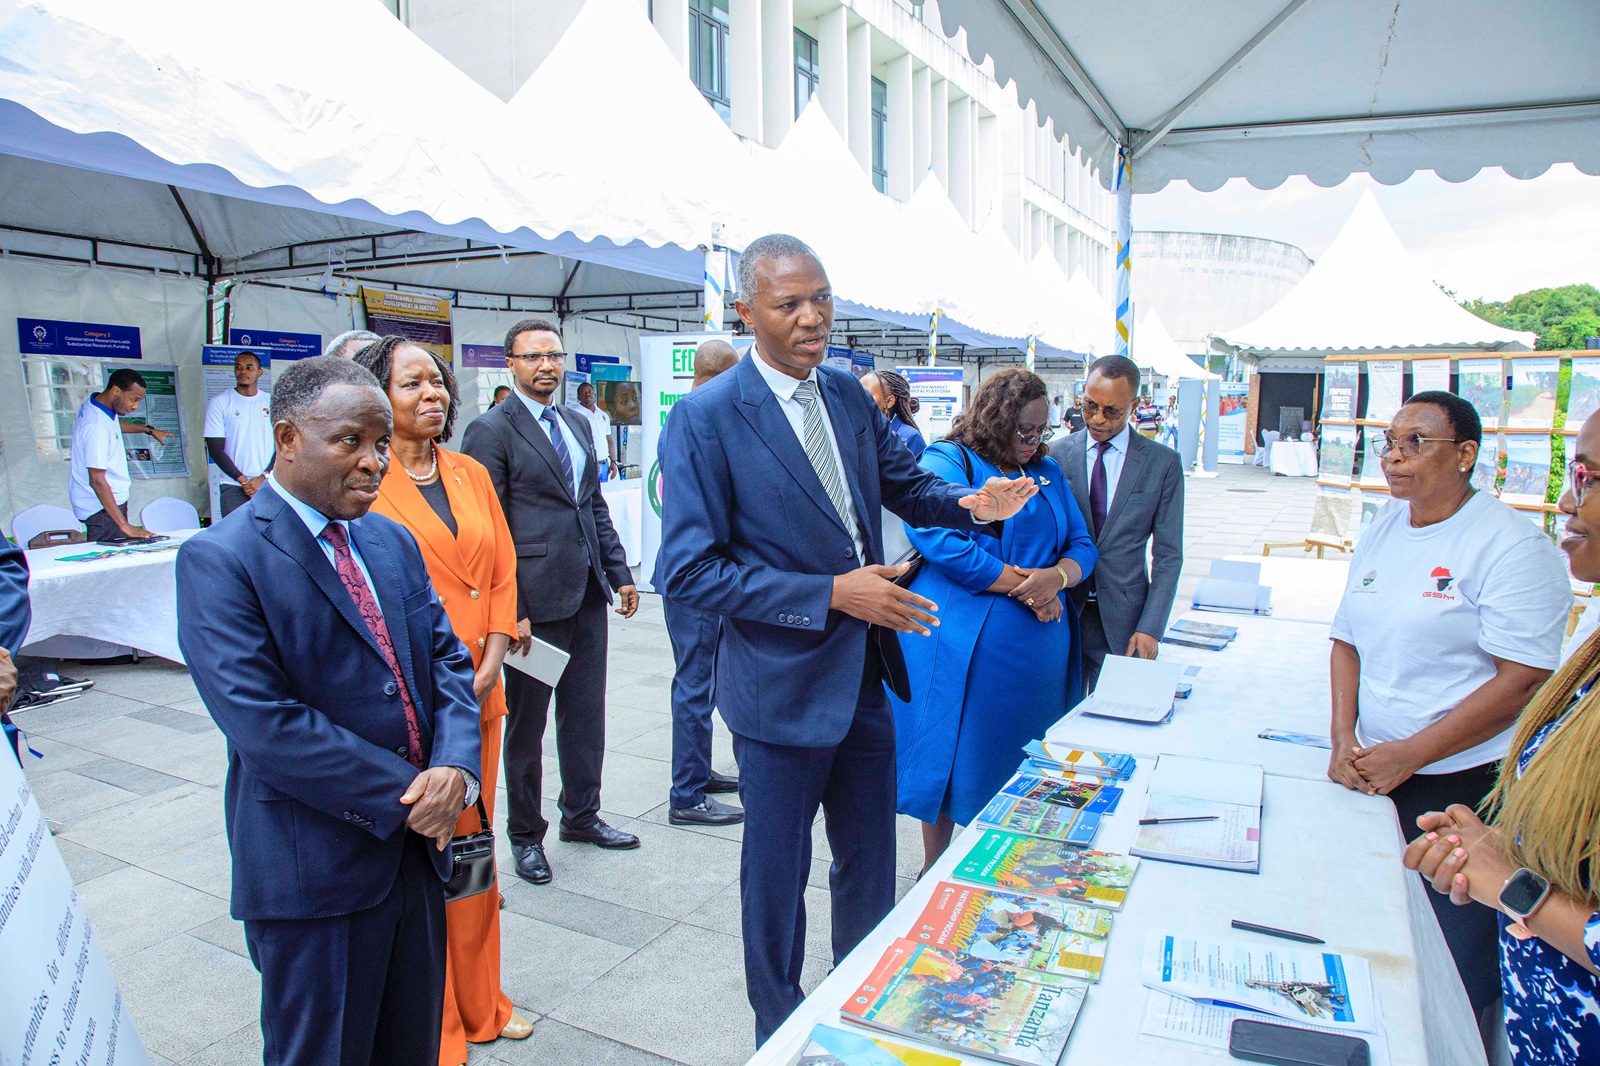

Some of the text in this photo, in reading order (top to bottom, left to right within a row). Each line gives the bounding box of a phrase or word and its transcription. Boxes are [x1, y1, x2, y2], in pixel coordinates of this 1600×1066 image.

[673, 349, 697, 372] EfD
[1422, 591, 1455, 600] GSM
[17, 854, 32, 885] with
[980, 859, 997, 877] PROGRAM
[991, 838, 1035, 880] Tanzania
[994, 836, 1014, 860] PARTNERSHIP
[937, 890, 969, 944] PARTNERSHIP PROGRAM
[950, 892, 994, 949] Tanzania
[47, 959, 60, 985] for
[56, 906, 73, 957] different
[56, 1030, 66, 1050] to
[63, 981, 80, 1031] climate
[75, 942, 89, 984] change
[1004, 982, 1039, 1044] PARTNERSHIP PROGRAM
[1015, 985, 1063, 1047] Tanzania
